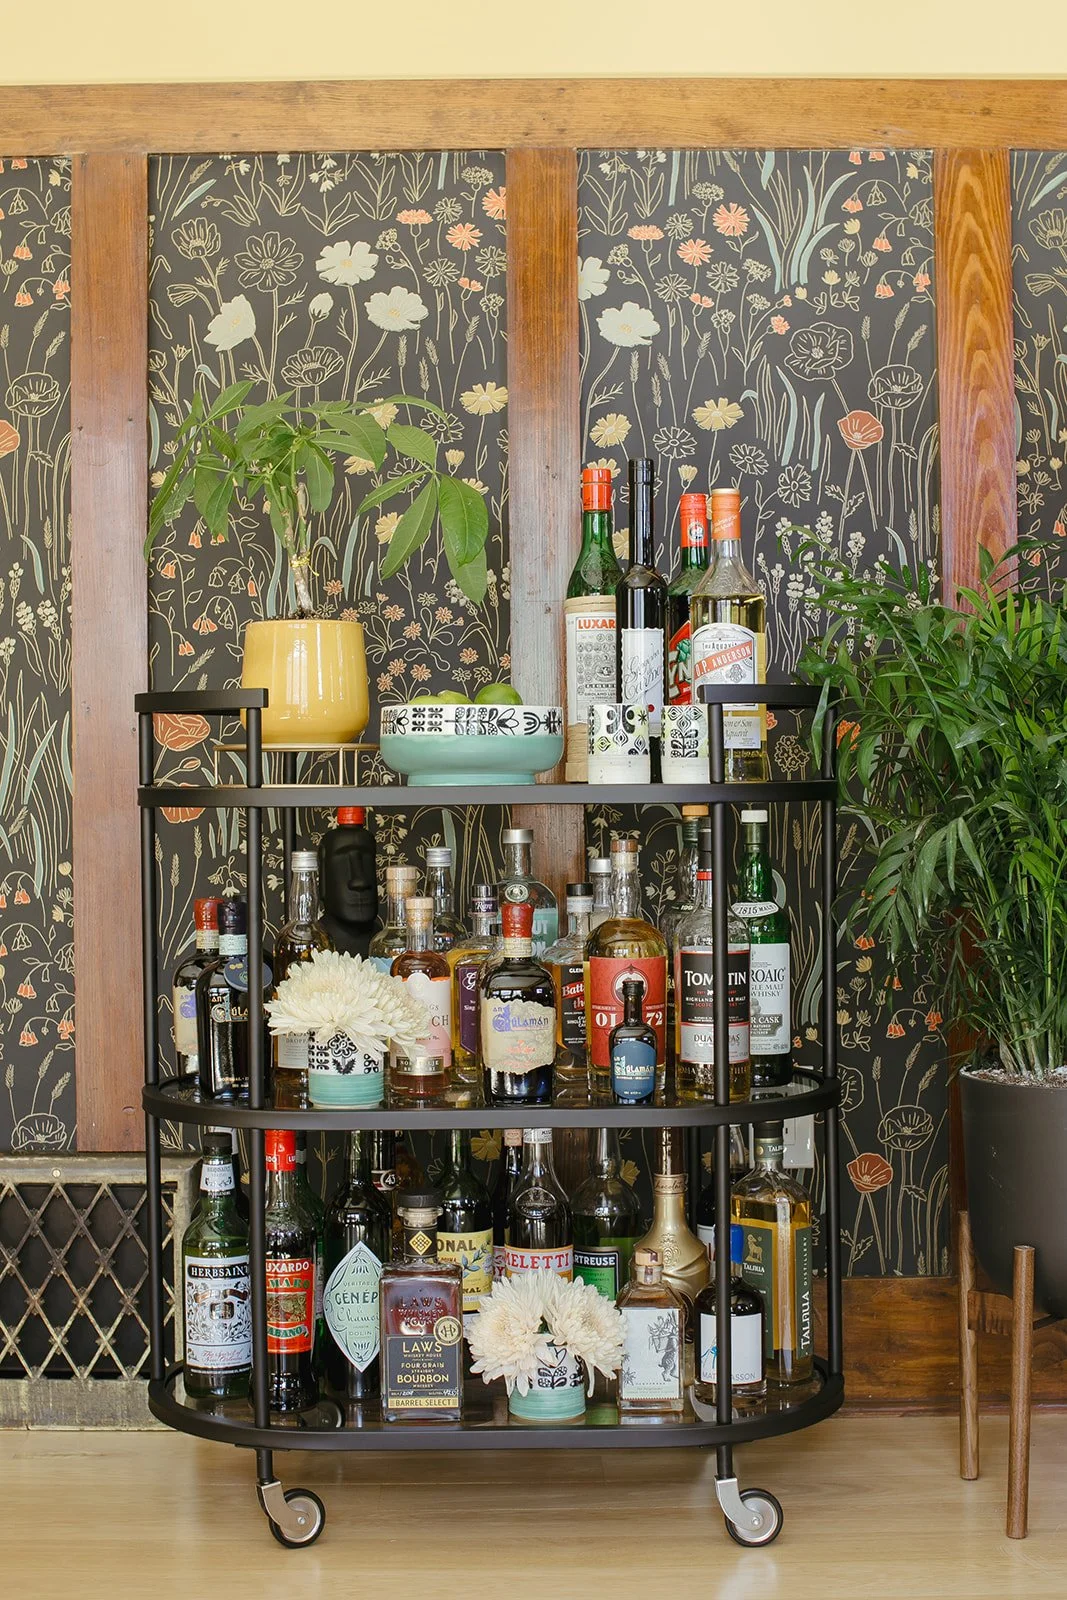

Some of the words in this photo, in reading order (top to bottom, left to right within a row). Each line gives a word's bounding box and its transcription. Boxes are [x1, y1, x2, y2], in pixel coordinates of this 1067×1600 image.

[711, 645, 751, 668] ANDERSON
[191, 1265, 248, 1280] HERBSAINT
[402, 1341, 442, 1353] LAWS
[397, 1374, 449, 1384] BOURBON
